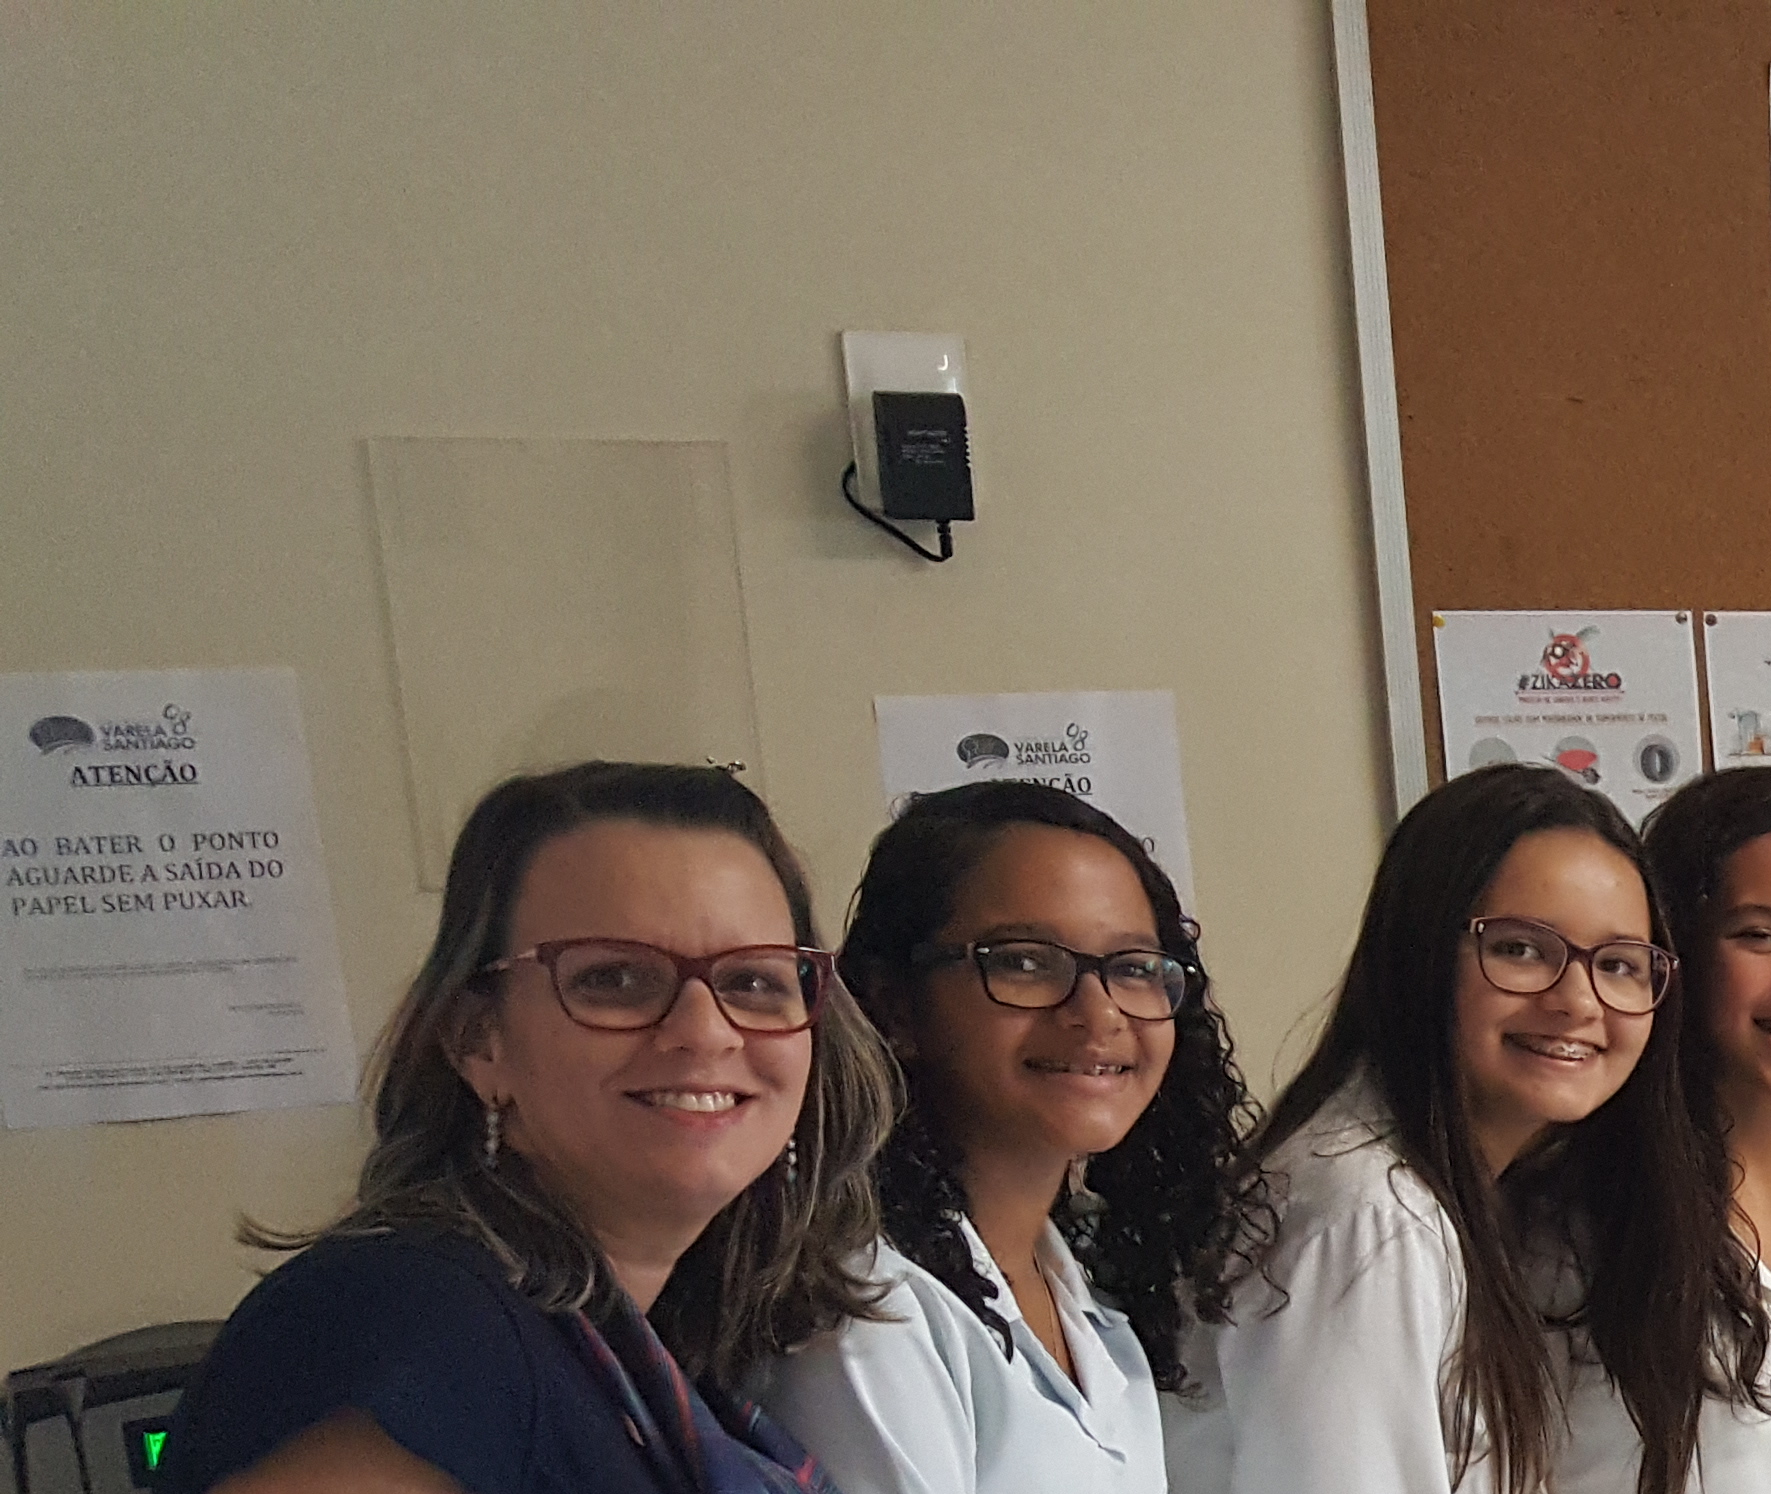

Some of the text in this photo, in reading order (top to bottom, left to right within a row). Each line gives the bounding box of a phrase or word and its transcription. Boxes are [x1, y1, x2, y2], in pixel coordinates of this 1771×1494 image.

[1517, 672, 1623, 690] #ZIKAZERO
[103, 736, 197, 750] SANTIAGO
[1013, 741, 1069, 753] VARELA
[1015, 752, 1092, 765] SANTIAGO
[71, 758, 200, 787] ATENÇÃO
[0, 831, 280, 858] AO BATER O PONTO
[6, 856, 285, 888] AGUARDE A SAÍDA DO
[11, 895, 97, 917] PAPEL
[102, 892, 156, 914] SEM
